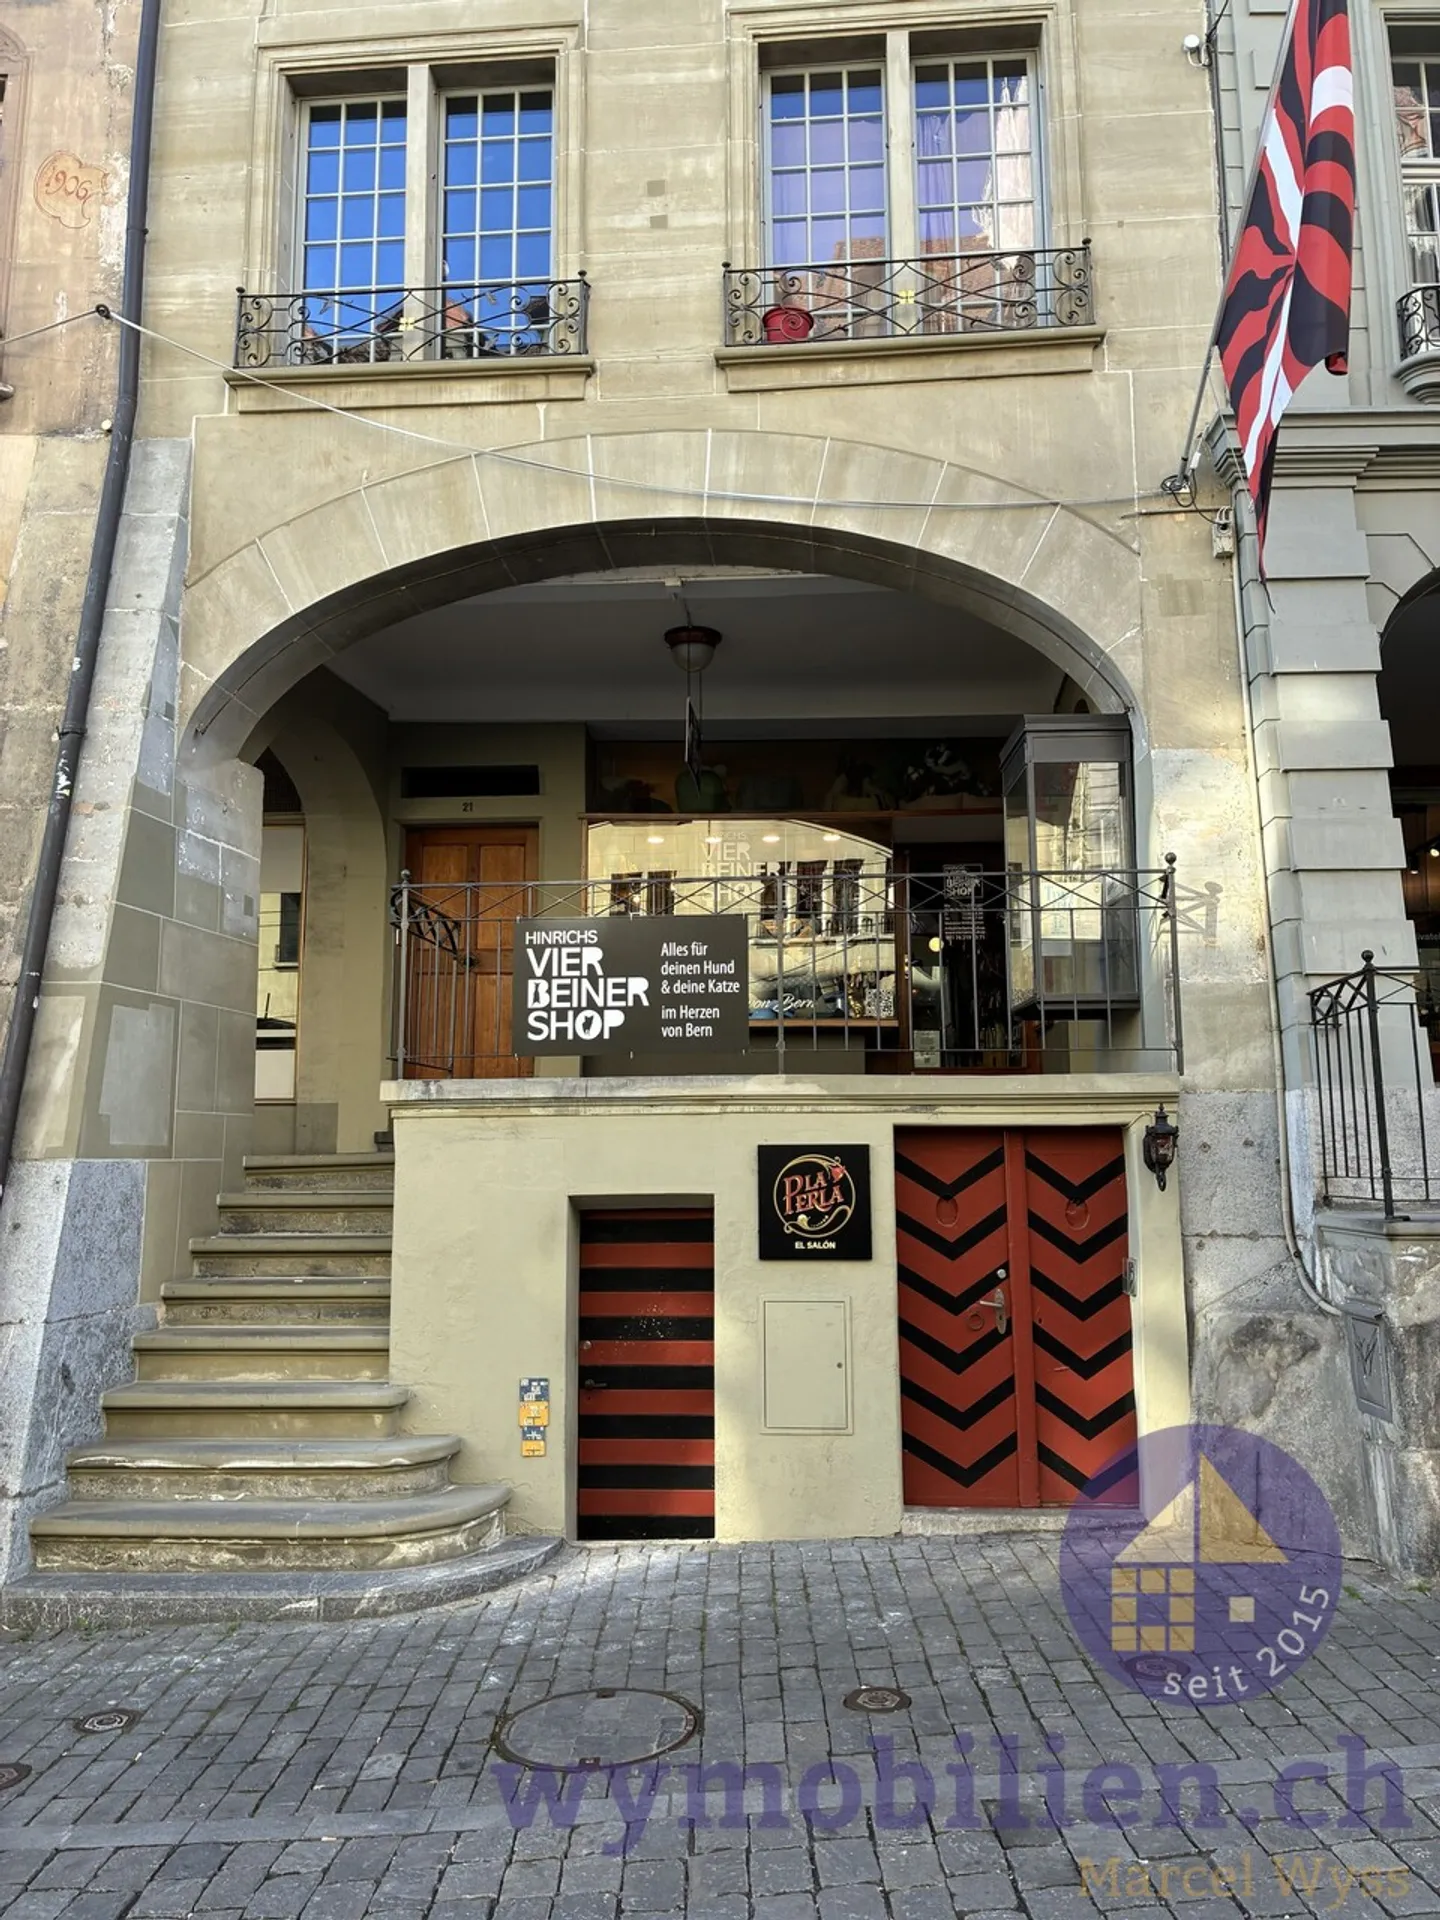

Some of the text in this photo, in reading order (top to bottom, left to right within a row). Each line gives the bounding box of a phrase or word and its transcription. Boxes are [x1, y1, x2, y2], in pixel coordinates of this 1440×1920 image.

[462, 802, 473, 812] 21
[525, 930, 599, 945] HINRICHS
[661, 941, 708, 957] Alles für
[527, 946, 604, 977] VIER
[661, 960, 735, 975] deinen Hund
[527, 977, 650, 1008] BEINER
[661, 979, 741, 994] & deine Katze
[661, 1006, 720, 1020] im Herzen
[527, 1009, 626, 1041] SHOP
[661, 1023, 713, 1037] von Bern
[795, 1240, 837, 1250] EL SALÓN
